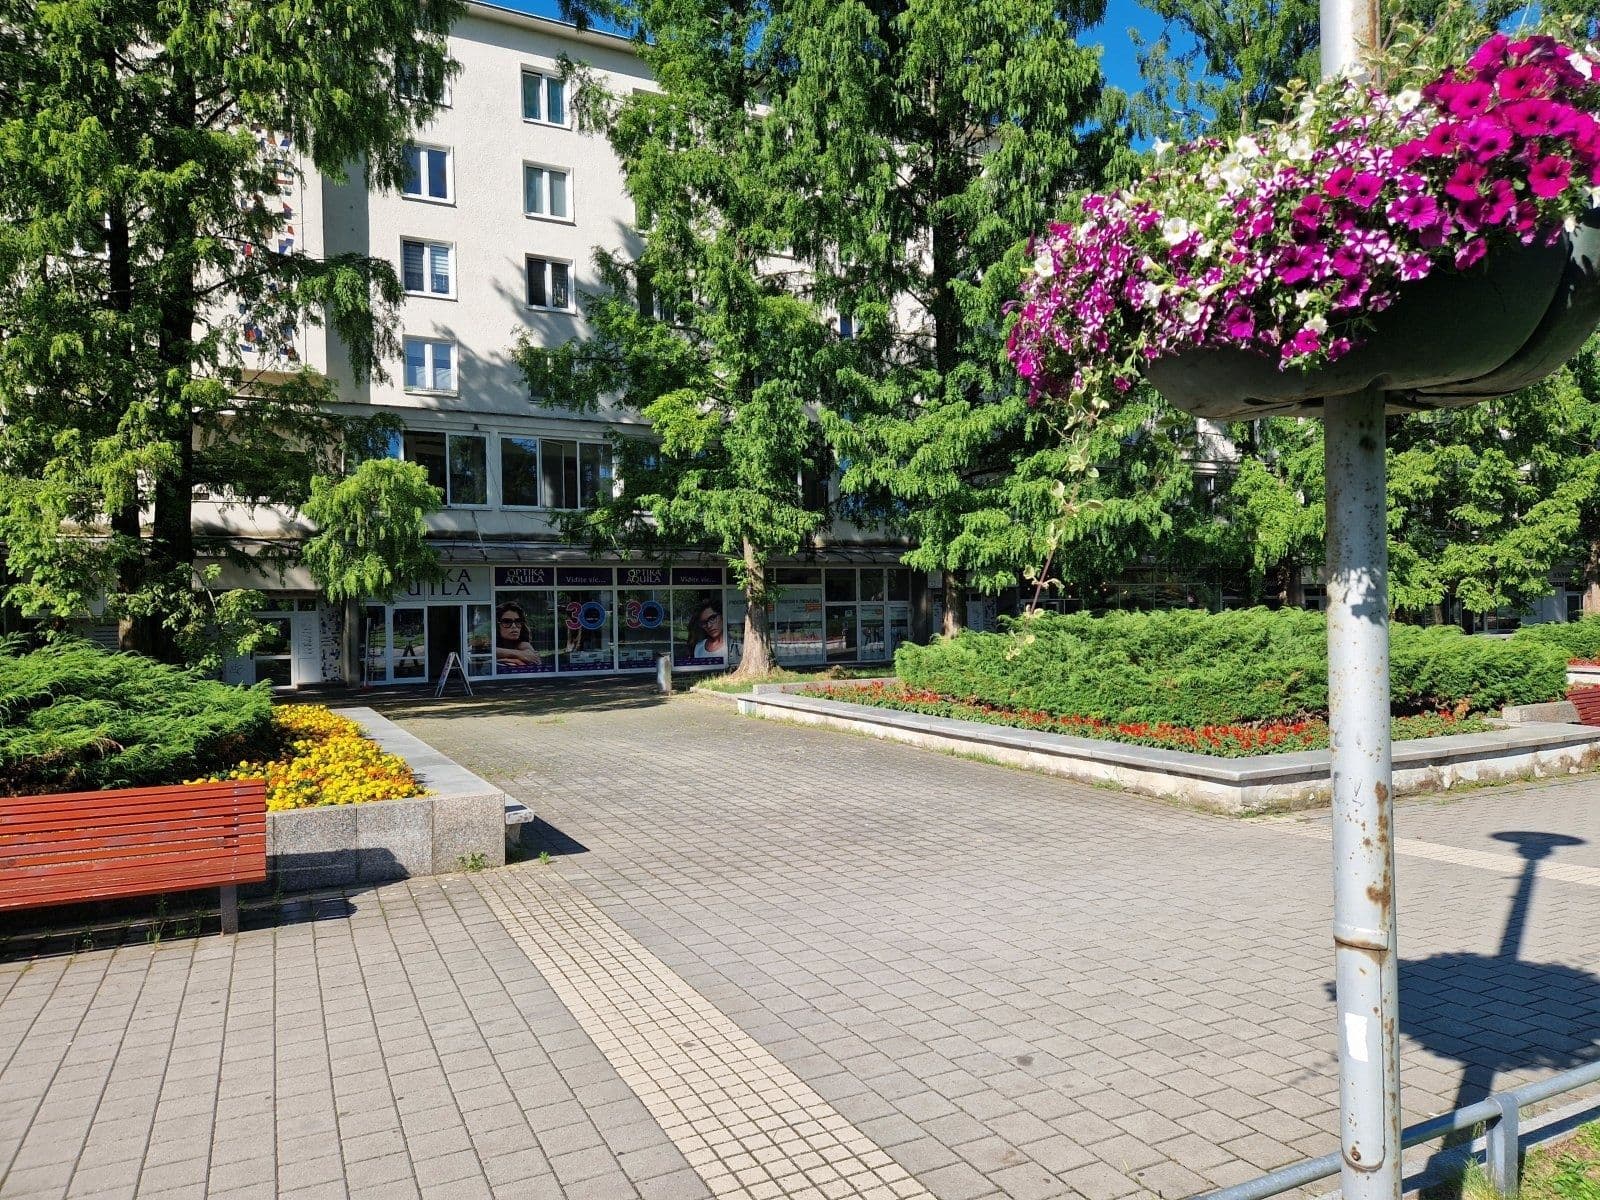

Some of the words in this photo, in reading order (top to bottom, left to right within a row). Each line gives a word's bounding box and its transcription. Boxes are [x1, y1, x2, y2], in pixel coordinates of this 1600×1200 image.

[507, 568, 545, 577] OPTIKA
[627, 568, 662, 577] OPTIKA
[505, 575, 545, 585] AQUILA
[626, 575, 662, 585] AQUILA
